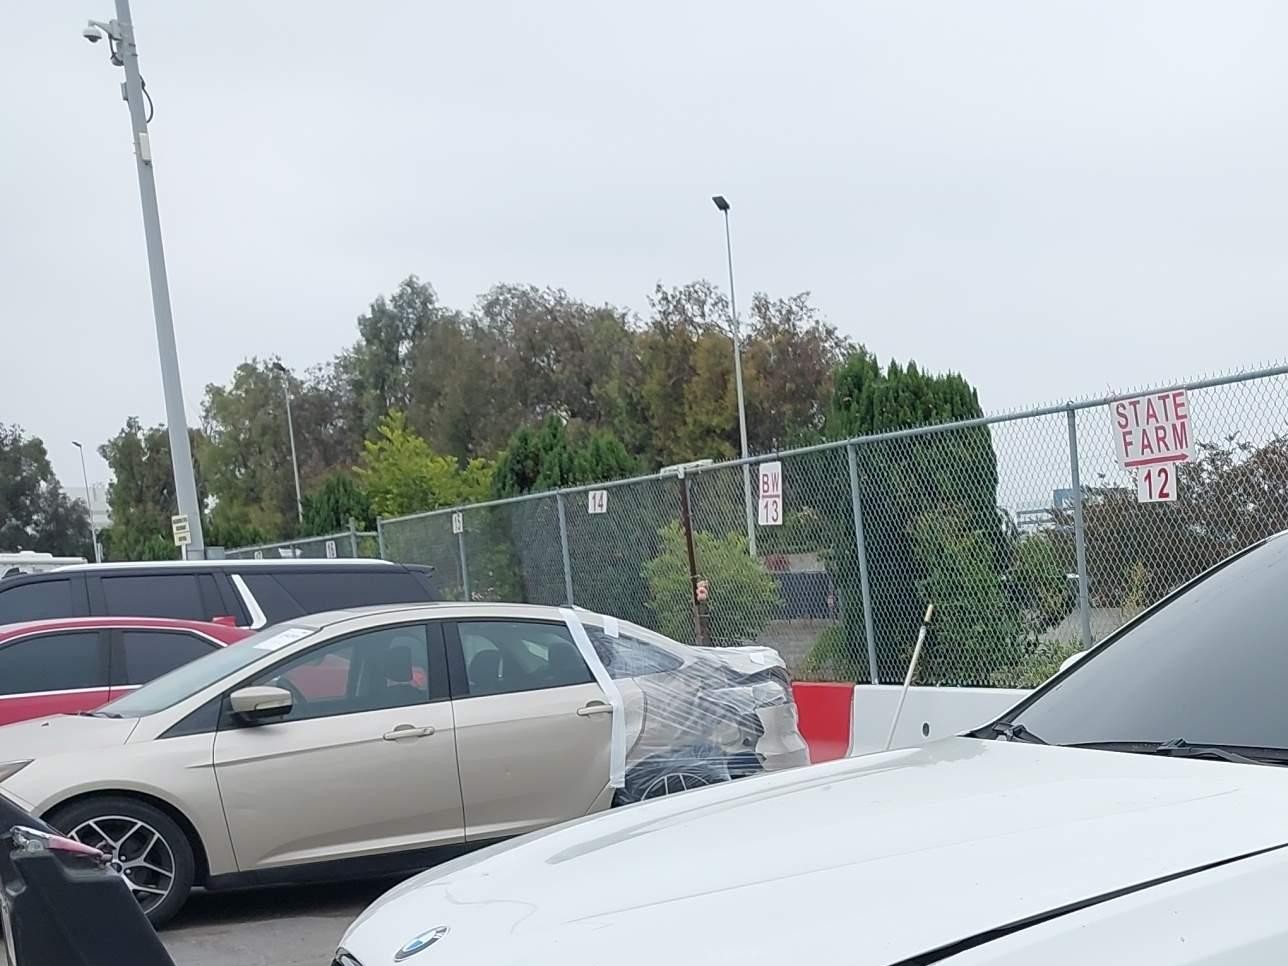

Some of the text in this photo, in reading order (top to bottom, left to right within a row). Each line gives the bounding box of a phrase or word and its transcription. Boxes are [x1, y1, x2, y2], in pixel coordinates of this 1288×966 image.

[1116, 391, 1188, 429] STATE
[1122, 421, 1189, 458] FARM
[762, 472, 780, 493] BW
[1144, 467, 1170, 500] 12
[591, 491, 604, 512] 14
[763, 499, 779, 523] 13
